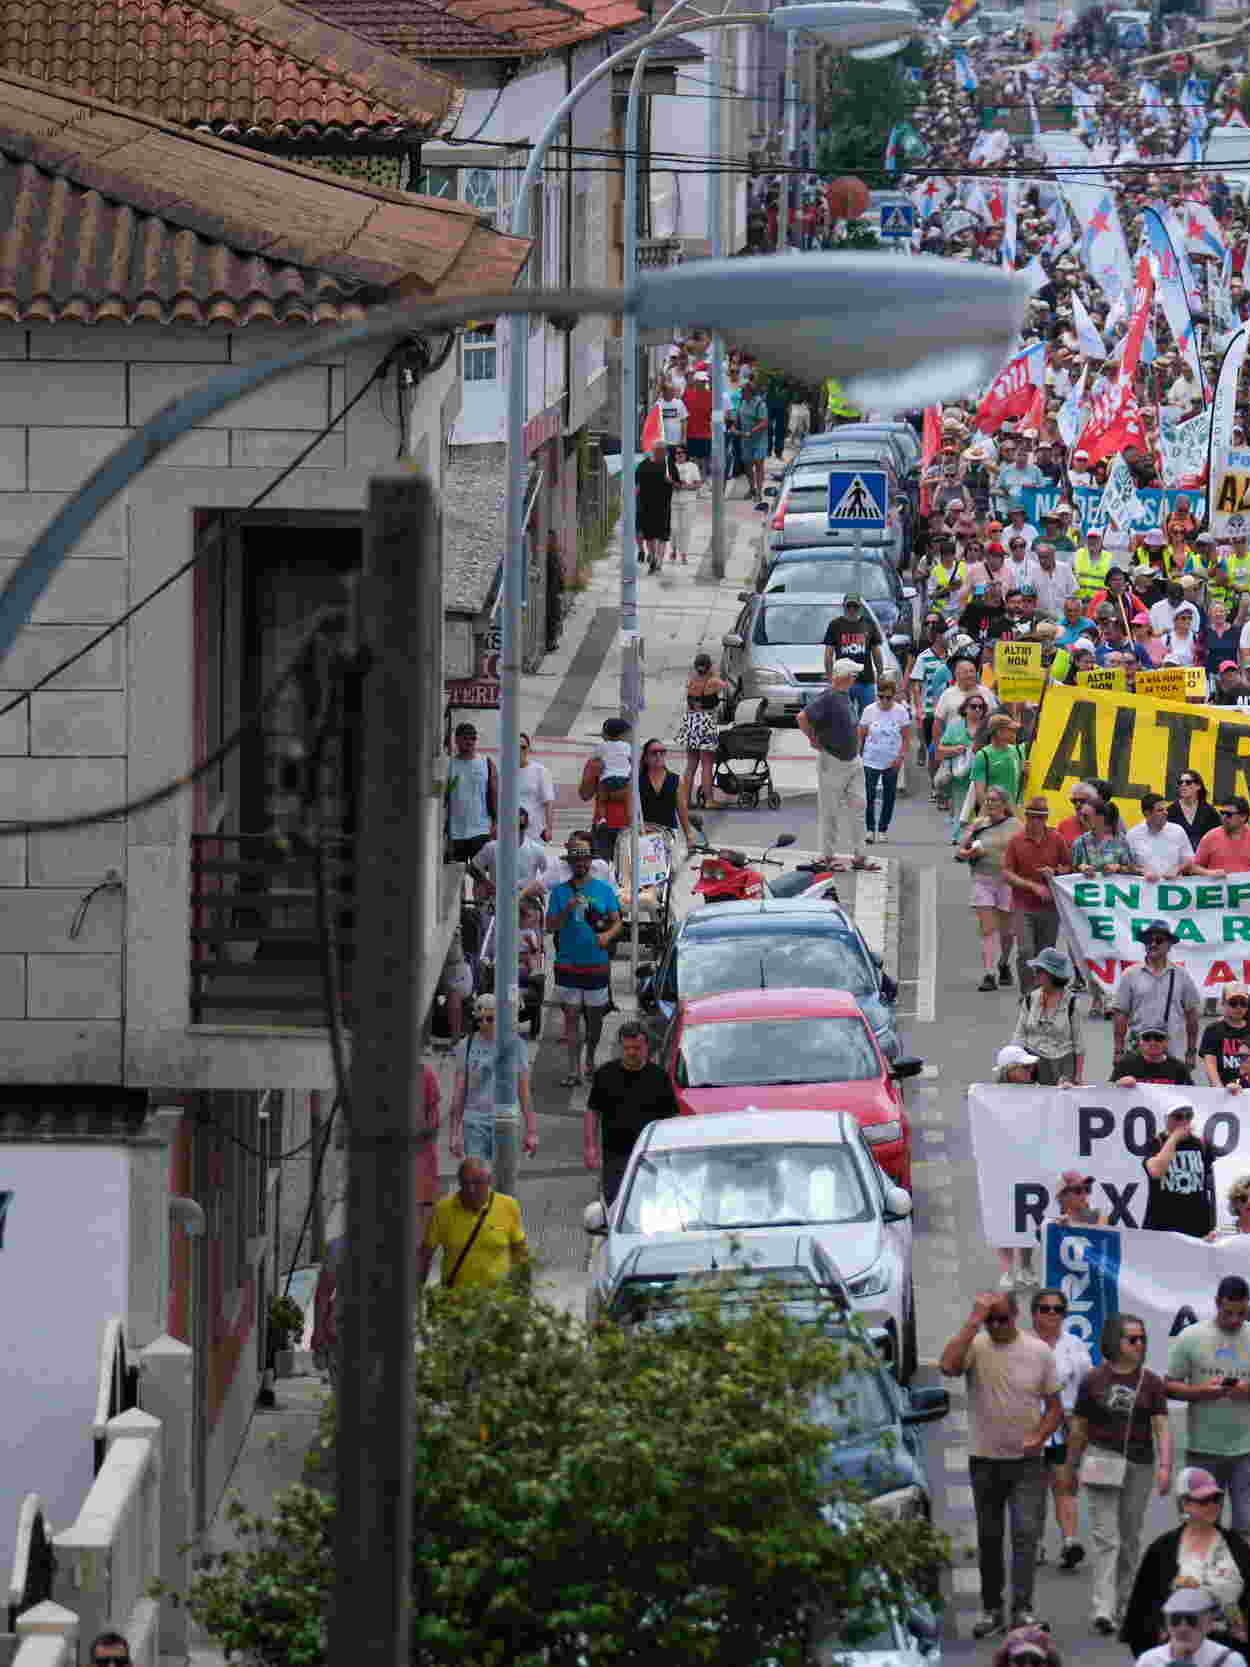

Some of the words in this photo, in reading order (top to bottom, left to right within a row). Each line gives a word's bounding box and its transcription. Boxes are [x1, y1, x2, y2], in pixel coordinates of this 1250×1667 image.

[1087, 671, 1116, 683] ALTRI
[1073, 881, 1141, 909] EN
[1088, 915, 1117, 942] E
[1079, 1106, 1239, 1160] POO
